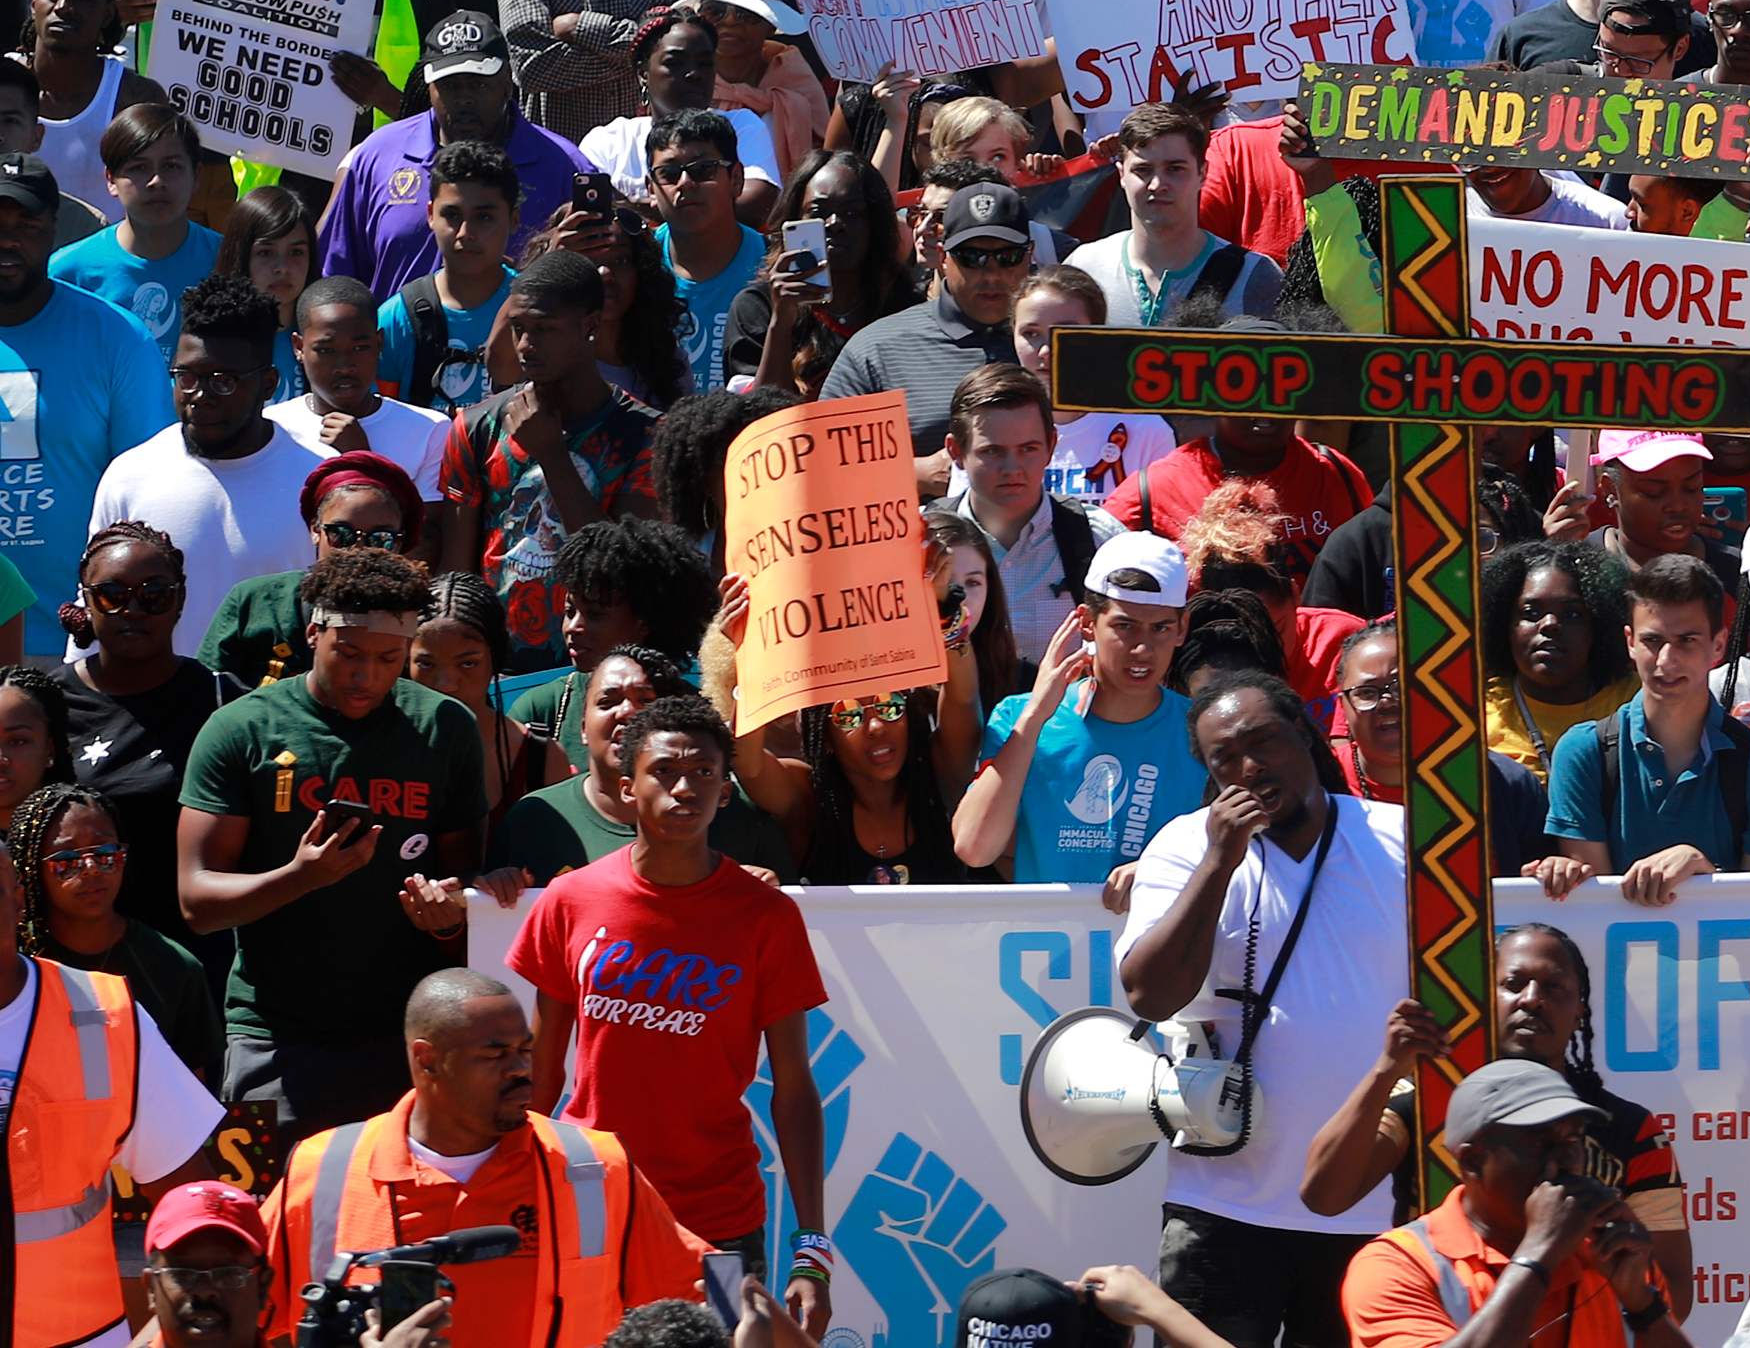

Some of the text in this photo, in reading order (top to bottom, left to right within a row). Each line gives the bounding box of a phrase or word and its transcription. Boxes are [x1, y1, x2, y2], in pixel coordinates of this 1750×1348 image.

[172, 9, 270, 45] BEHIND THE
[177, 29, 323, 87] WE NEED
[169, 84, 333, 156] SCHOOLS
[197, 59, 293, 112] GOOD
[1311, 82, 1525, 147] DEMAND
[1480, 246, 1748, 329] NO MORE
[1133, 349, 1718, 422] STOP SHOOTING
[740, 420, 898, 498] STOP THIS
[746, 499, 909, 578] SENSELESS
[759, 580, 909, 649] VIOLENCE
[1121, 763, 1159, 857] CHICAGO
[584, 992, 706, 1036] FOR PEACE
[968, 1317, 1052, 1340] CHICAGO
